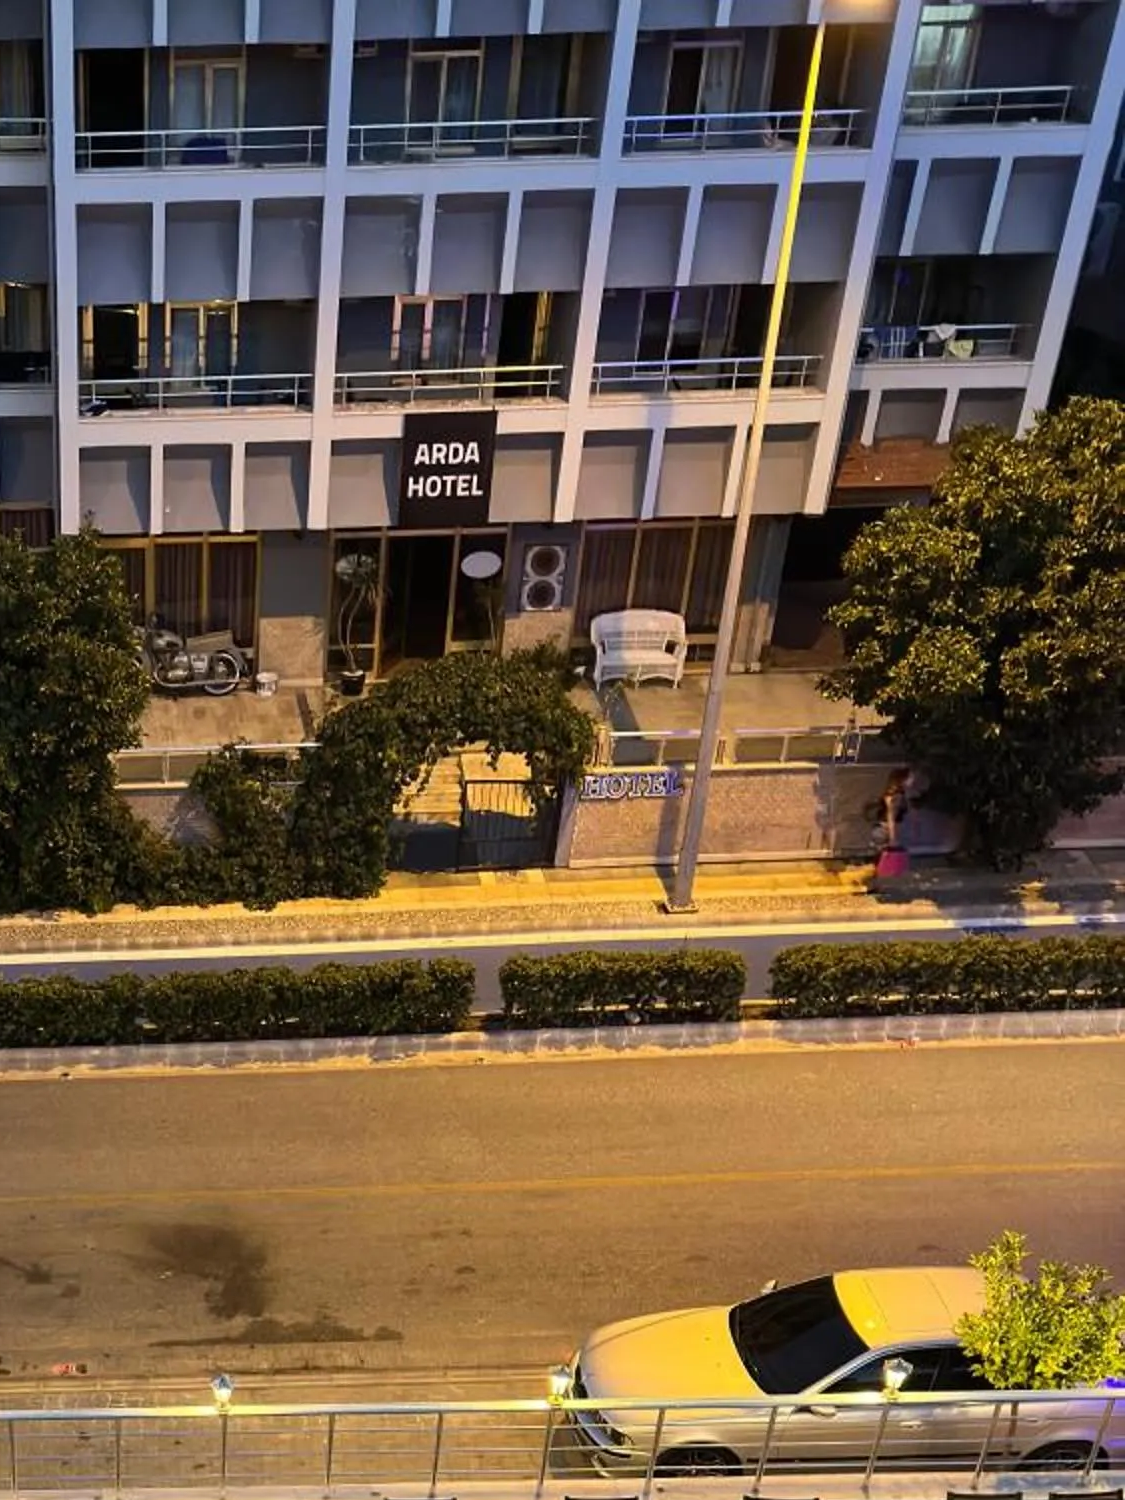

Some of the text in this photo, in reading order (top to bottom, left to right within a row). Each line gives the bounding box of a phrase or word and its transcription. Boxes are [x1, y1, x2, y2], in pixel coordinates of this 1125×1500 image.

[414, 442, 480, 466] ARDA
[407, 474, 484, 498] HOTEL
[580, 772, 683, 799] HOTEL
